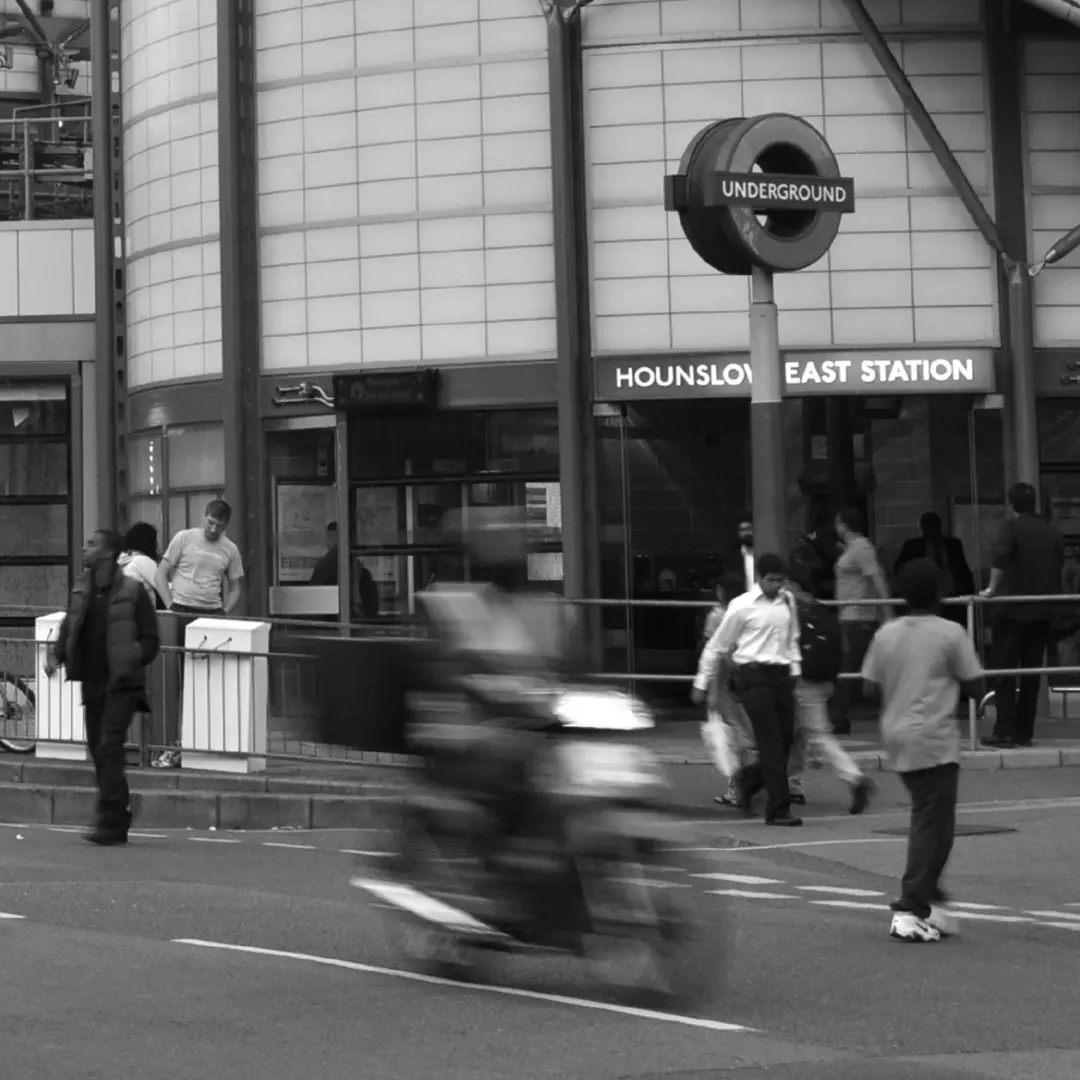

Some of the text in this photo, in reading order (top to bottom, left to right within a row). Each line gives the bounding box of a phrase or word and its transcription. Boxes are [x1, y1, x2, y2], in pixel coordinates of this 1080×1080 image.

[722, 180, 846, 203] UNDERGROUND
[785, 361, 851, 384] EAST
[860, 358, 974, 382] STATION
